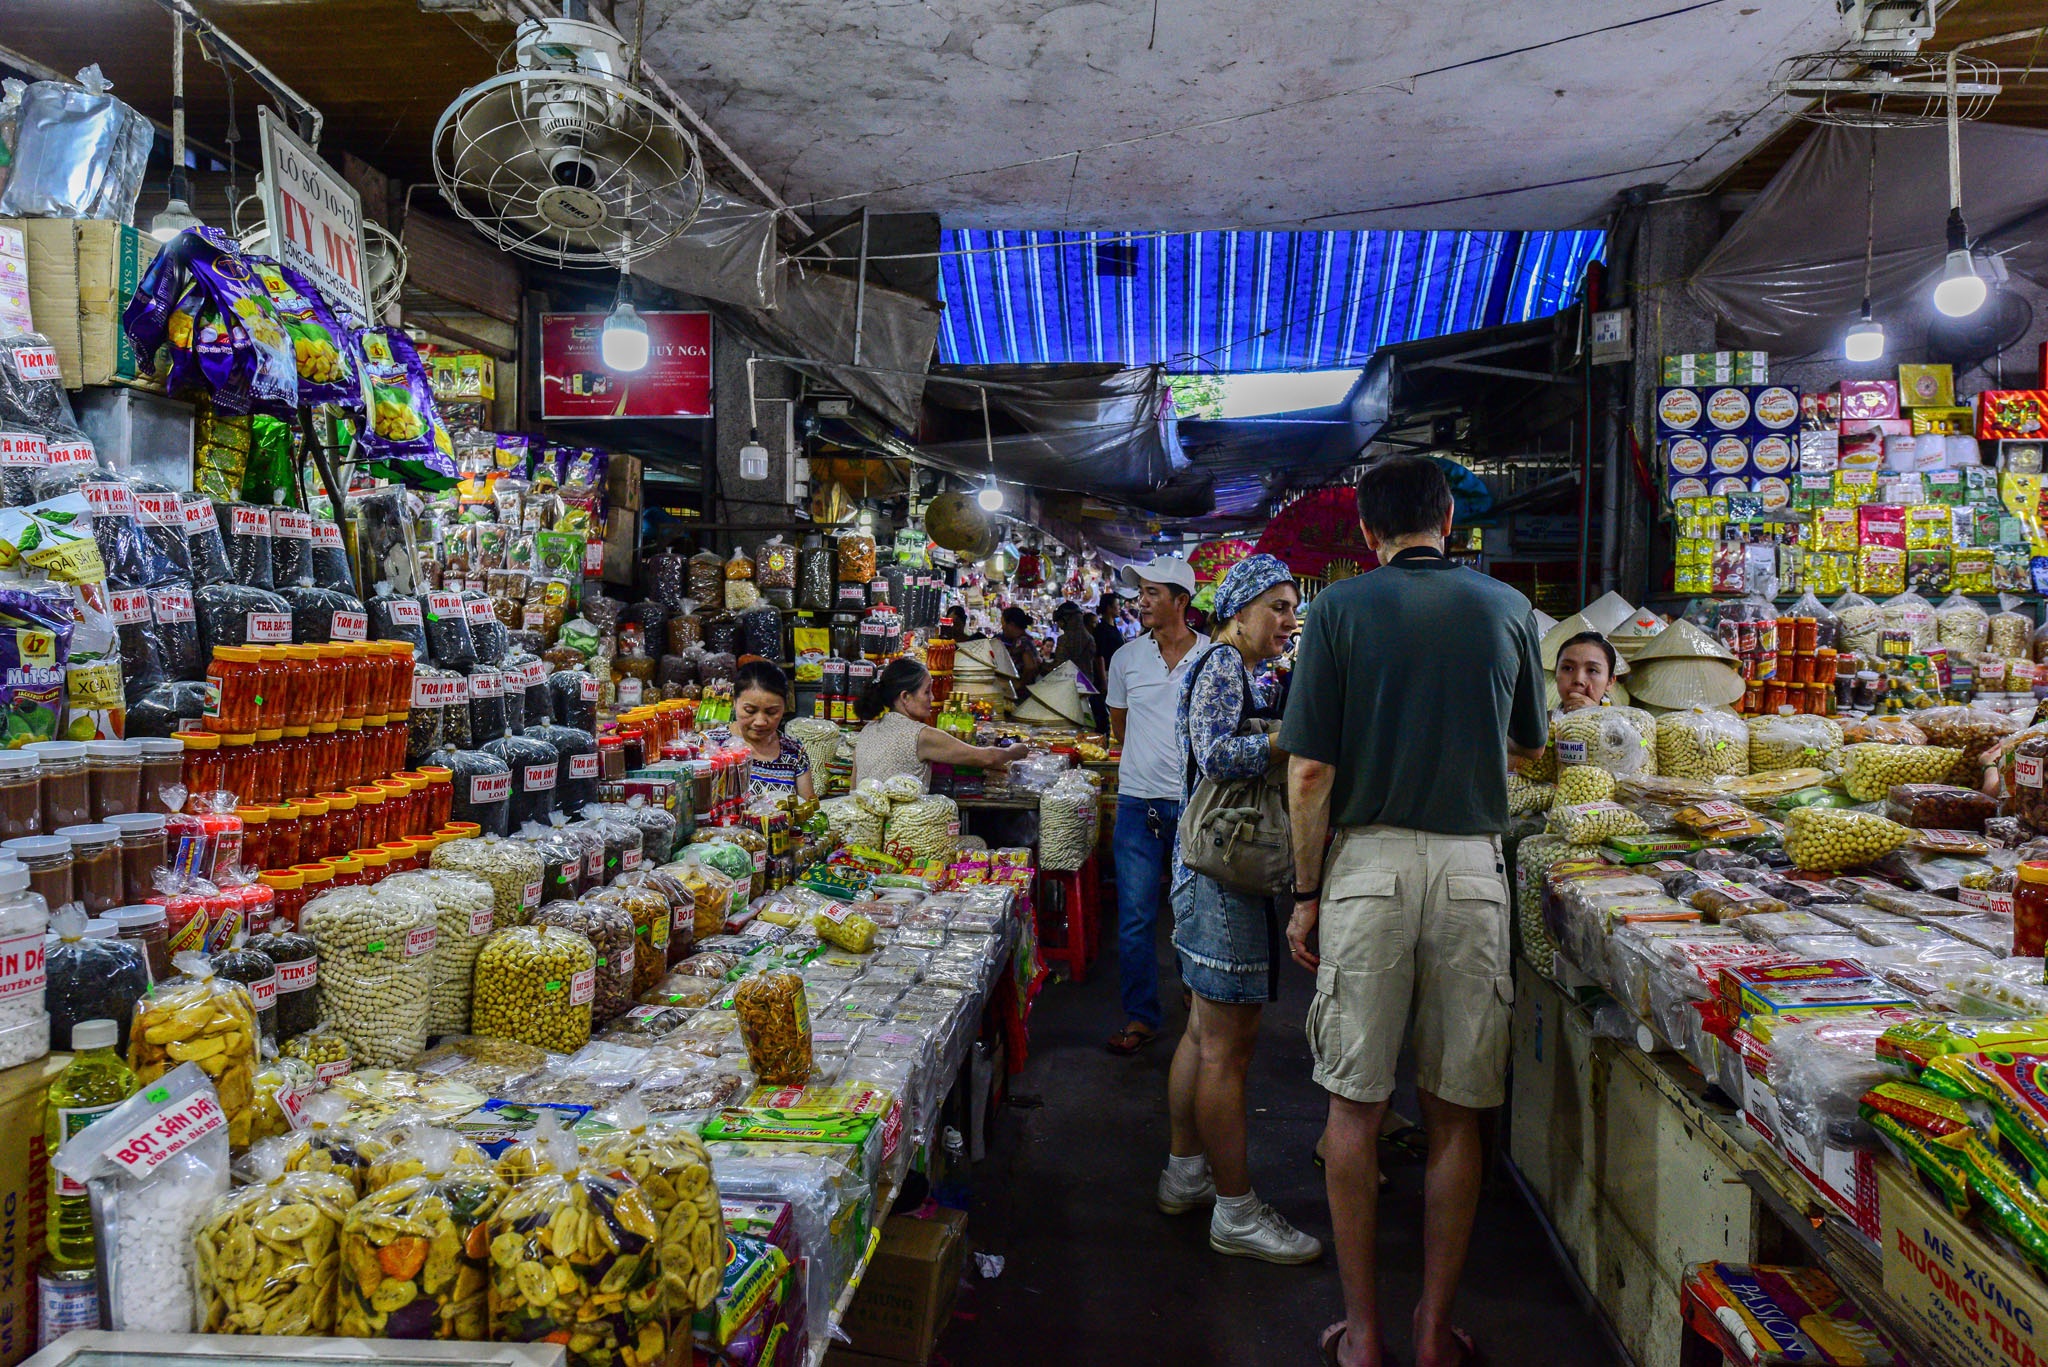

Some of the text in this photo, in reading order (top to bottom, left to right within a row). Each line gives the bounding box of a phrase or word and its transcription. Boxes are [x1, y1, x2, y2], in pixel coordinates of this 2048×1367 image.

[279, 147, 354, 231] LÔ SỐ 10-12
[559, 200, 589, 219] SENKO
[678, 345, 707, 356] NGA
[185, 508, 200, 522] RÀ
[311, 527, 322, 537] RÀ
[44, 555, 76, 572] OÀI
[257, 619, 272, 631] TRÀ
[477, 778, 492, 791] TRÀ
[281, 962, 318, 981] TIM SE
[257, 983, 276, 999] TIM
[116, 1132, 159, 1165] BỘT
[155, 1113, 192, 1138] SẮN
